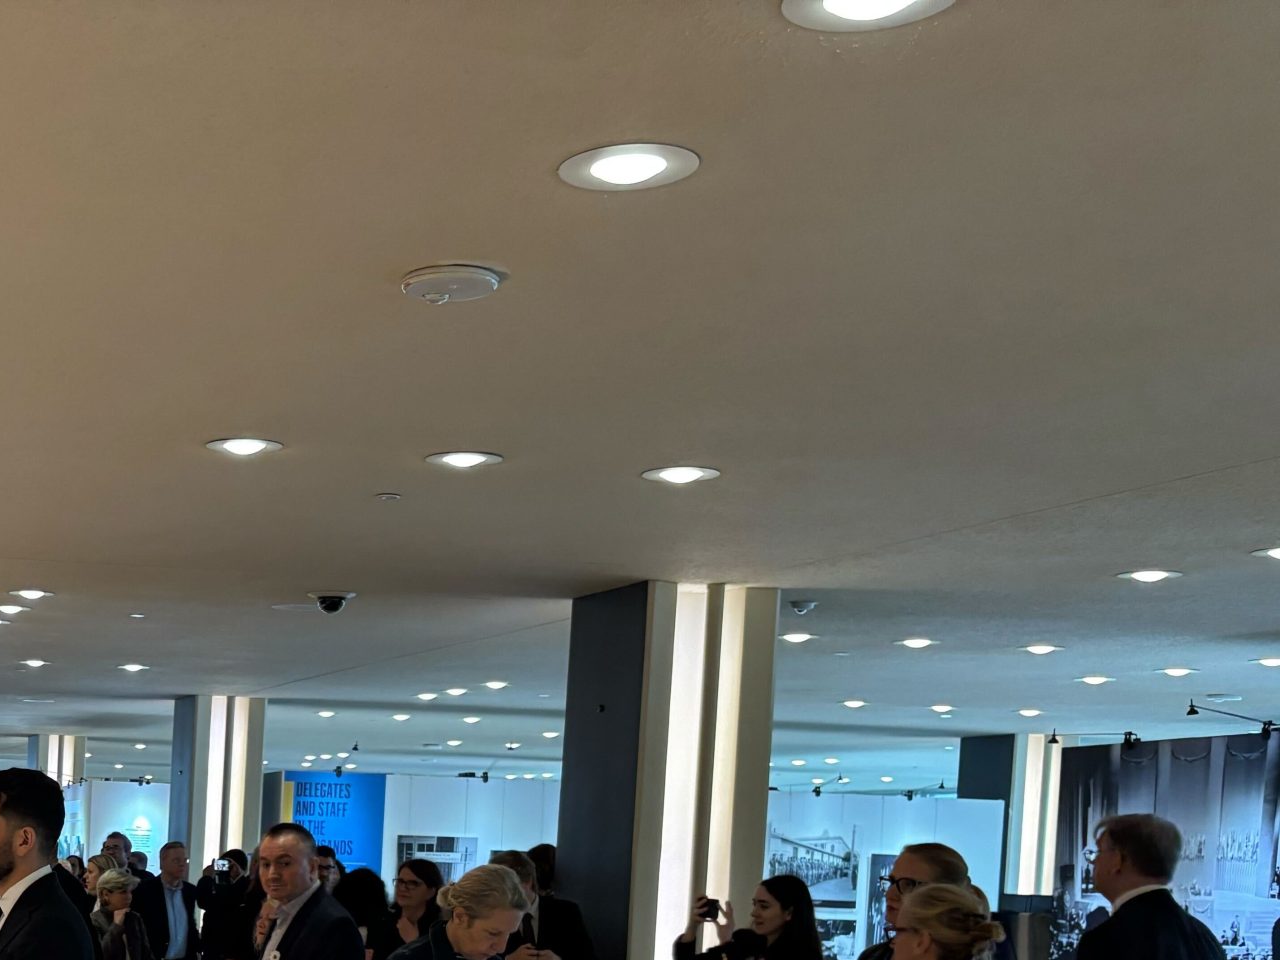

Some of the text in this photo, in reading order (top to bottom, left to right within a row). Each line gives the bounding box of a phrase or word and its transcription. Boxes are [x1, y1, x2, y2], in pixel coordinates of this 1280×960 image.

[296, 782, 351, 798] DELEGATES
[295, 800, 348, 817] AND STAFF
[307, 820, 325, 836] THE
